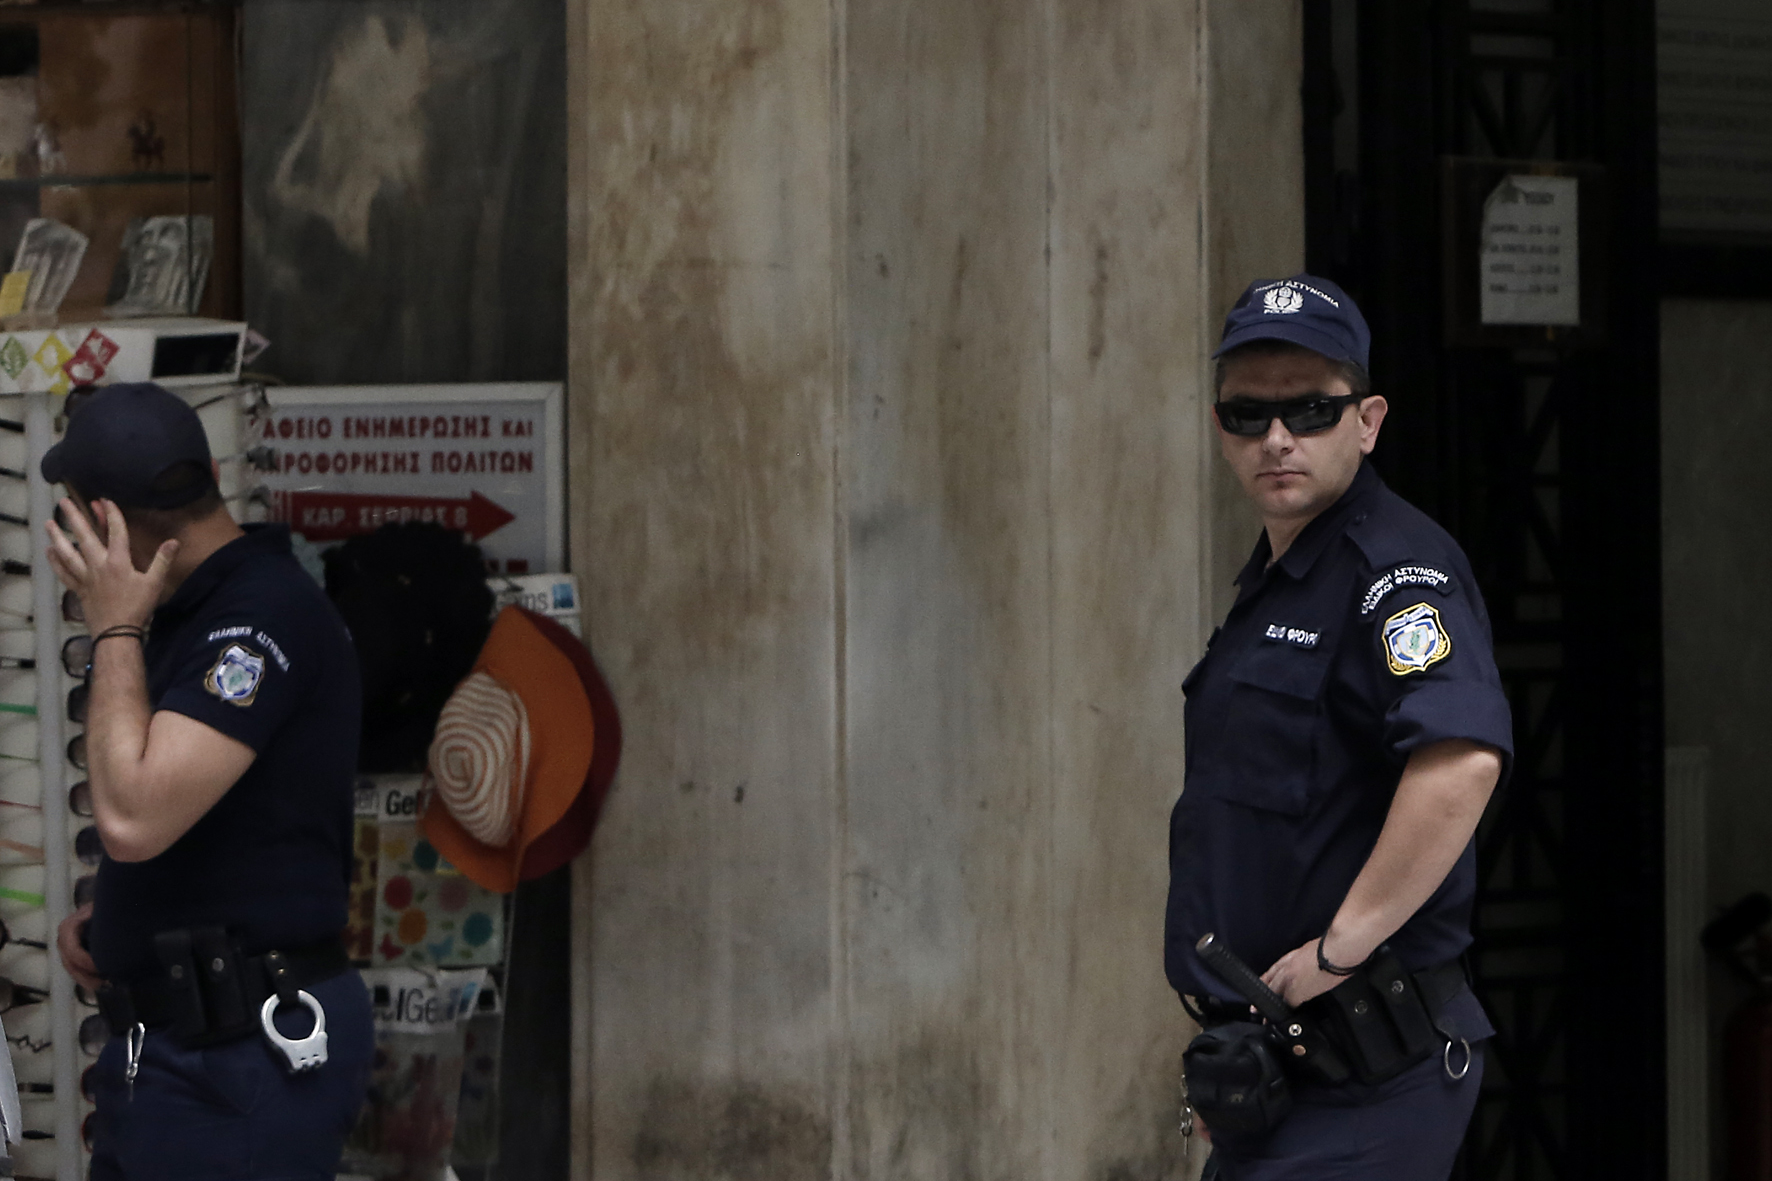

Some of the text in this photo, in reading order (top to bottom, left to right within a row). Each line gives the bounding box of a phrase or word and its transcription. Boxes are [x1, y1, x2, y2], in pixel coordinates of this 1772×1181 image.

[343, 416, 490, 439] ΕΝΗΜΕΡΩΣΗΣ
[501, 421, 533, 437] ΚΑΙ
[431, 451, 533, 473] ΠΟΛΙΤΩΝ
[1394, 566, 1449, 584] ΑΣΤΥΝΟΜΙΑ
[1395, 574, 1439, 587] ΦΡΟΥΡΟΙ
